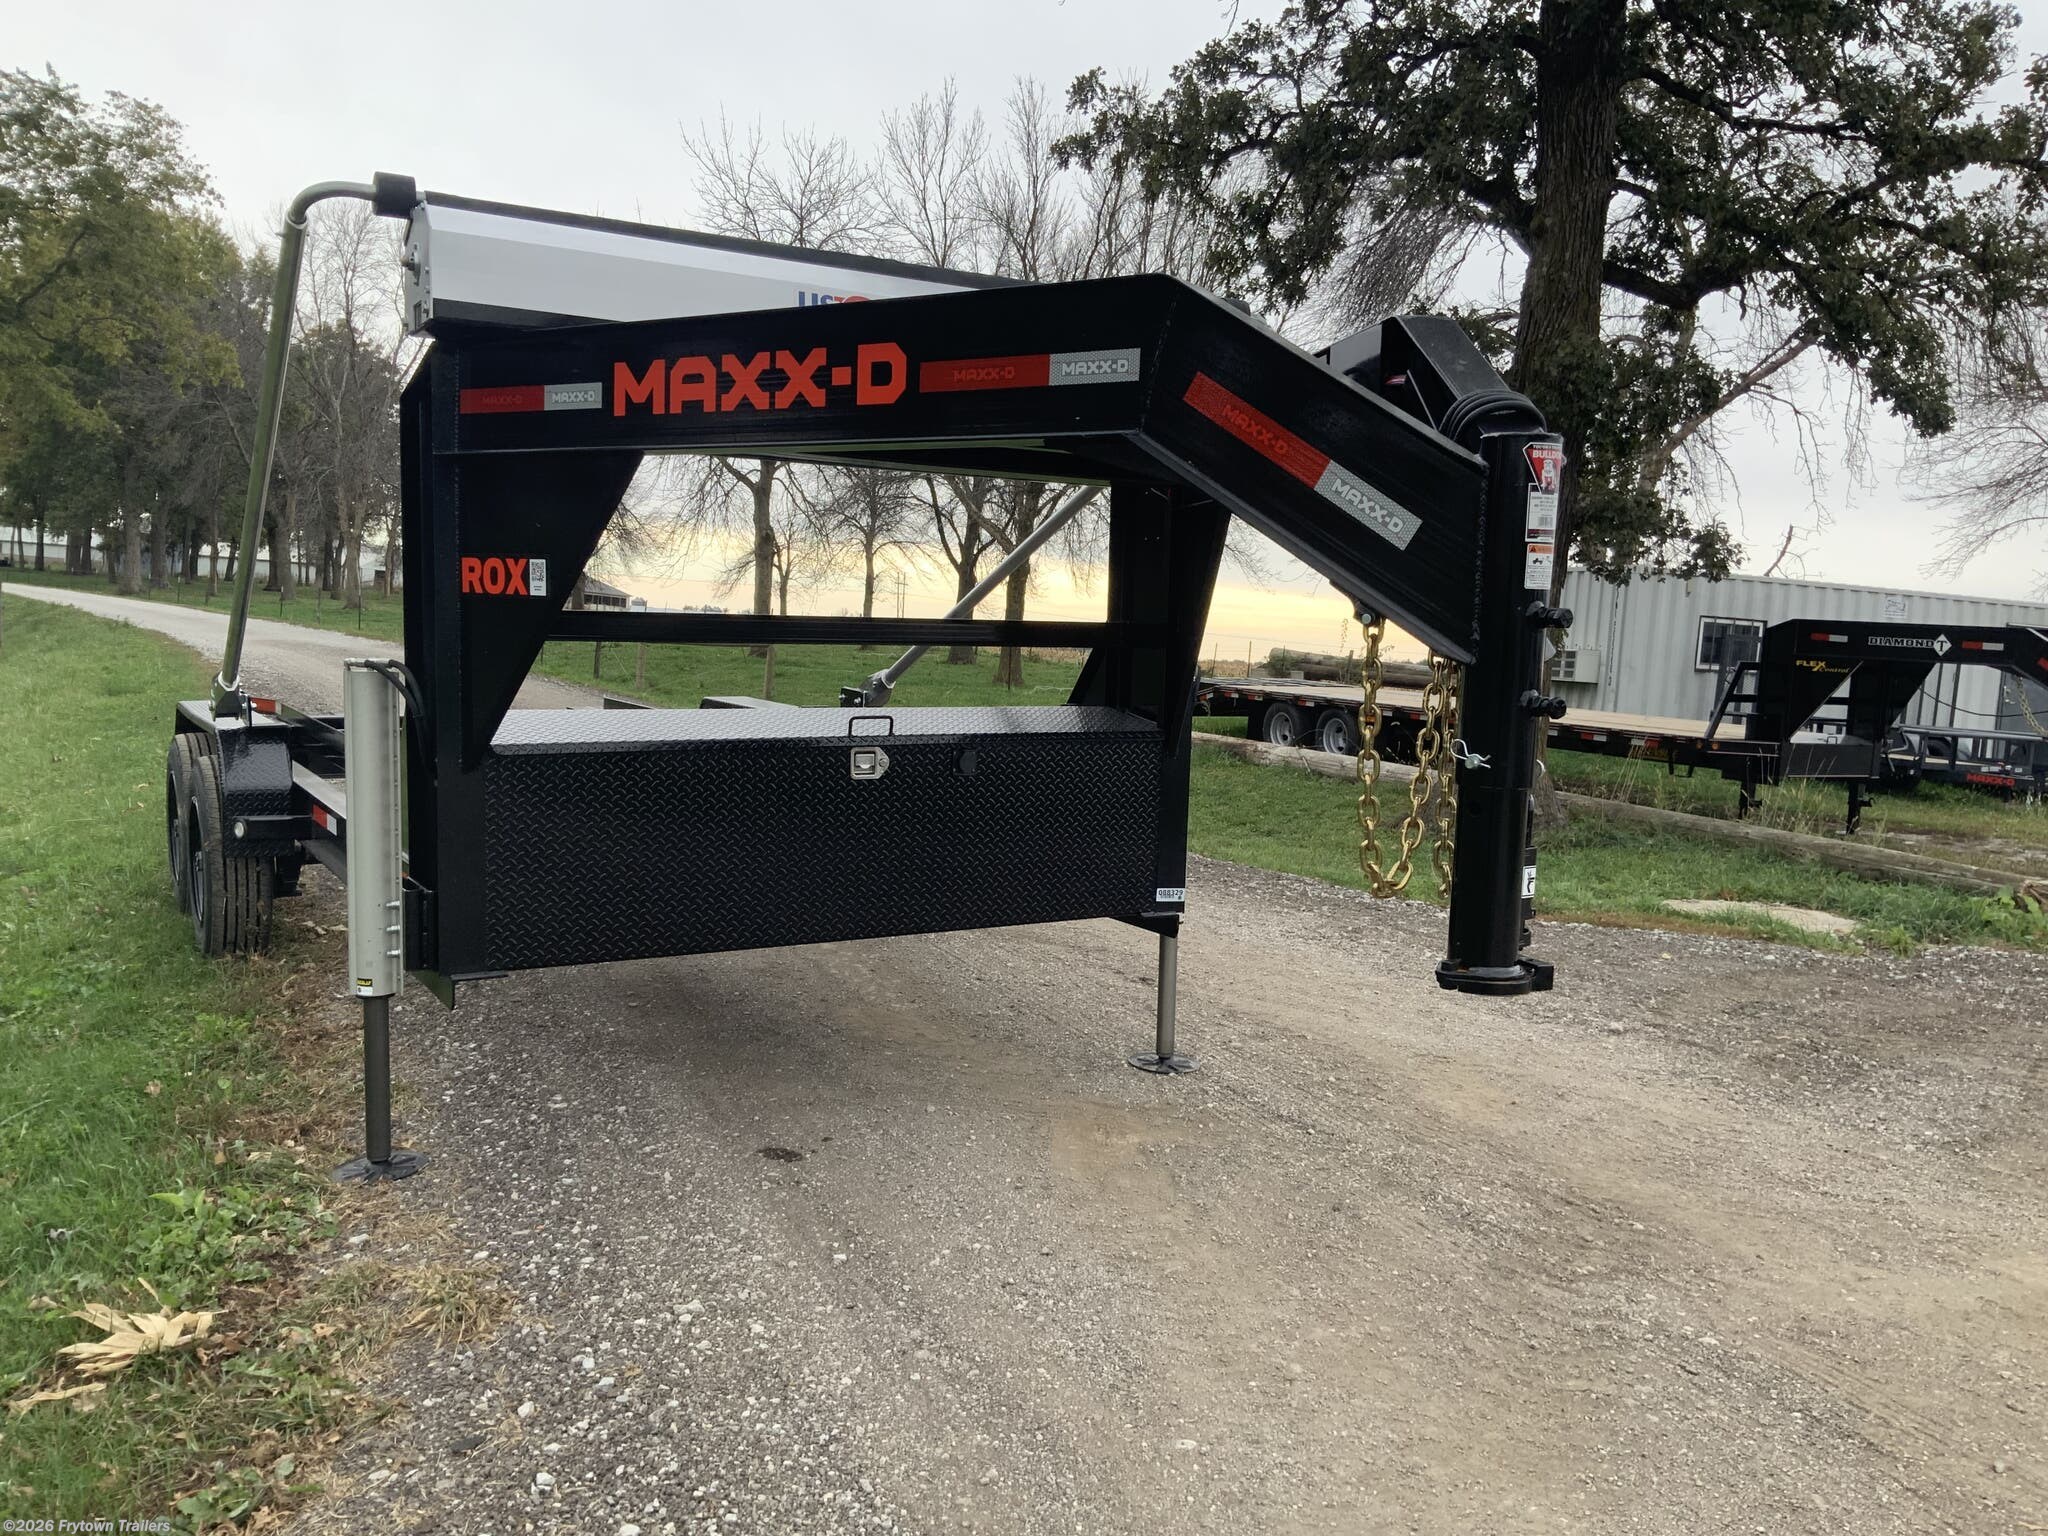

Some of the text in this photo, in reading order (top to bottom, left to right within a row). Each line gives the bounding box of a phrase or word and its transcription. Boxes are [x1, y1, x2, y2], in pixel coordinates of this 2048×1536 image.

[953, 366, 1016, 382] MAXX-D
[1061, 359, 1130, 376] MAXX-D
[613, 343, 907, 417] MAXX-D
[551, 391, 595, 403] MAXX-D
[1222, 403, 1288, 454] MAXX-D
[1331, 478, 1404, 534] MAXX-D
[461, 557, 528, 595] ROX
[1868, 636, 1934, 648] DIAMOND
[1796, 660, 1826, 672] FLEX
